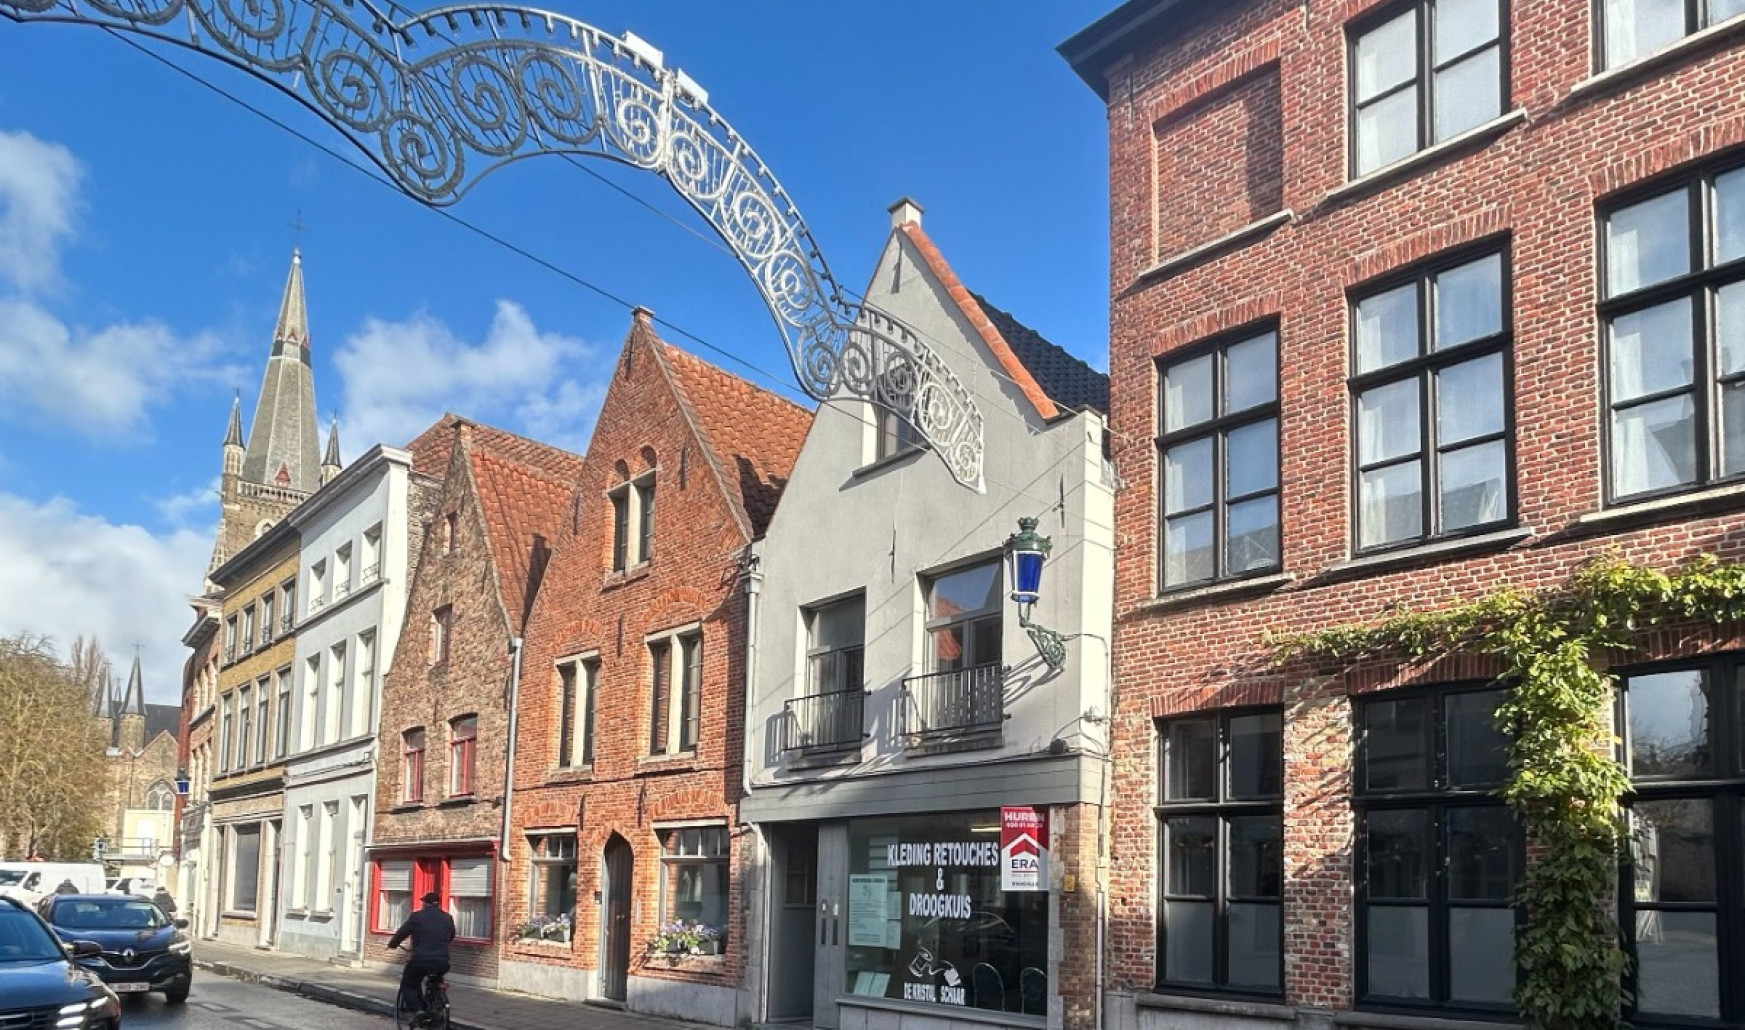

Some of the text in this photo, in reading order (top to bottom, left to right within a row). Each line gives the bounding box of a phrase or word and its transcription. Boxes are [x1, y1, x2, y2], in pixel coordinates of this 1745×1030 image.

[887, 842, 999, 866] KLEDING RETOUCHES
[1011, 859, 1039, 869] ERA
[935, 867, 945, 891] &
[909, 892, 971, 919] DROOGKUIS
